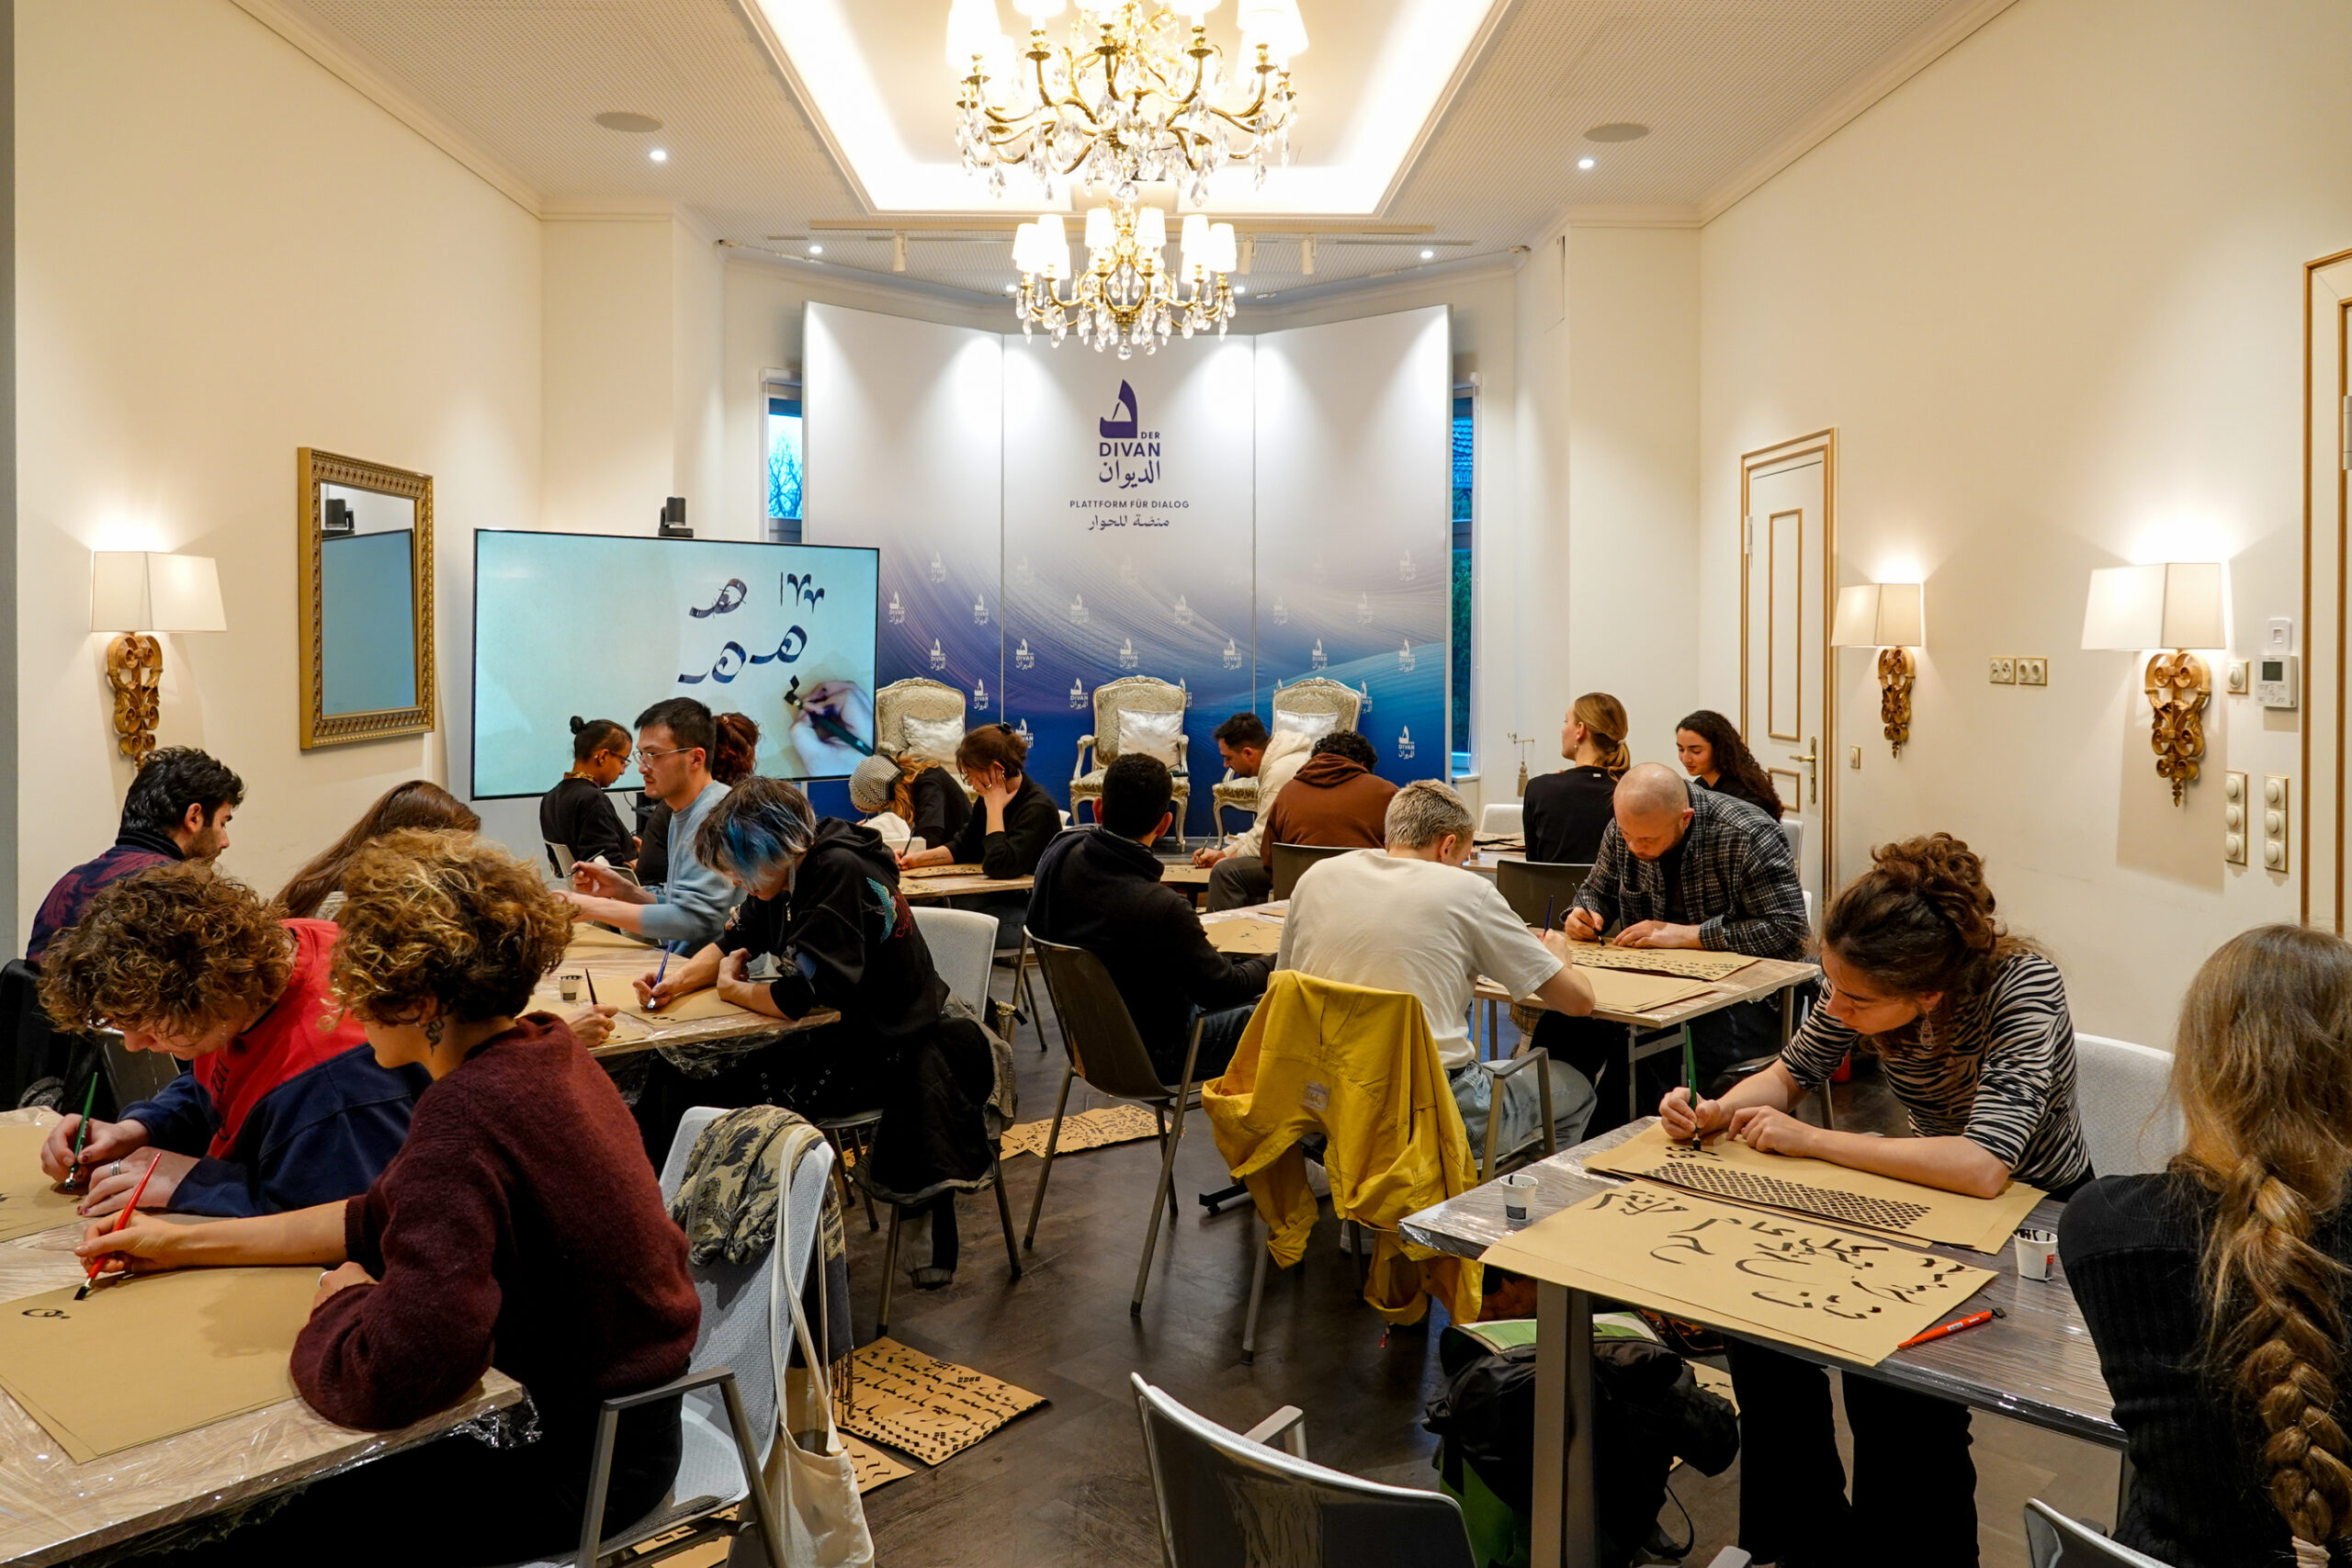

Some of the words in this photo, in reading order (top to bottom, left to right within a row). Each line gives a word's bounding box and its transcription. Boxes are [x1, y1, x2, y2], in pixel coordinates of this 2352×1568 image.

[1099, 442, 1160, 457] DIVAN
[1099, 459, 1160, 489] الديوان
[1130, 499, 1148, 508] FÜR
[1151, 501, 1190, 509] DIALOG
